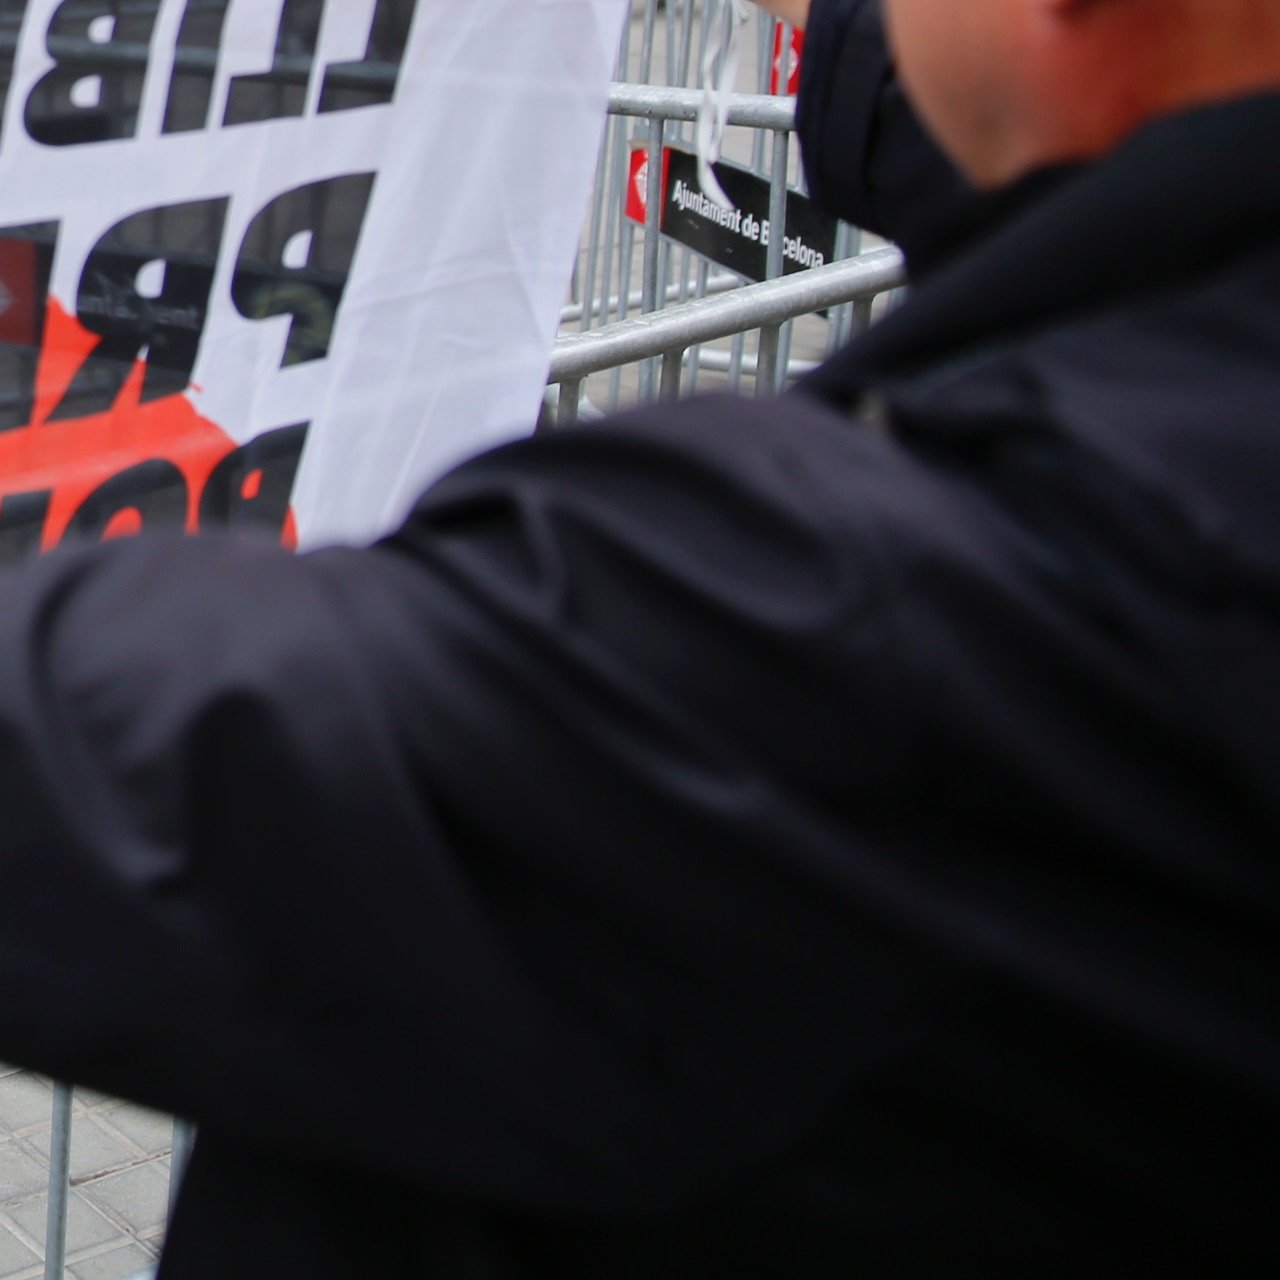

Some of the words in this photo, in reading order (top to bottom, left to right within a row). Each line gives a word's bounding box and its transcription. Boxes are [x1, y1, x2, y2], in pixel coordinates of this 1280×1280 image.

[672, 179, 742, 233] Ajuntament
[742, 213, 759, 240] de
[760, 219, 825, 269] Bcelona
